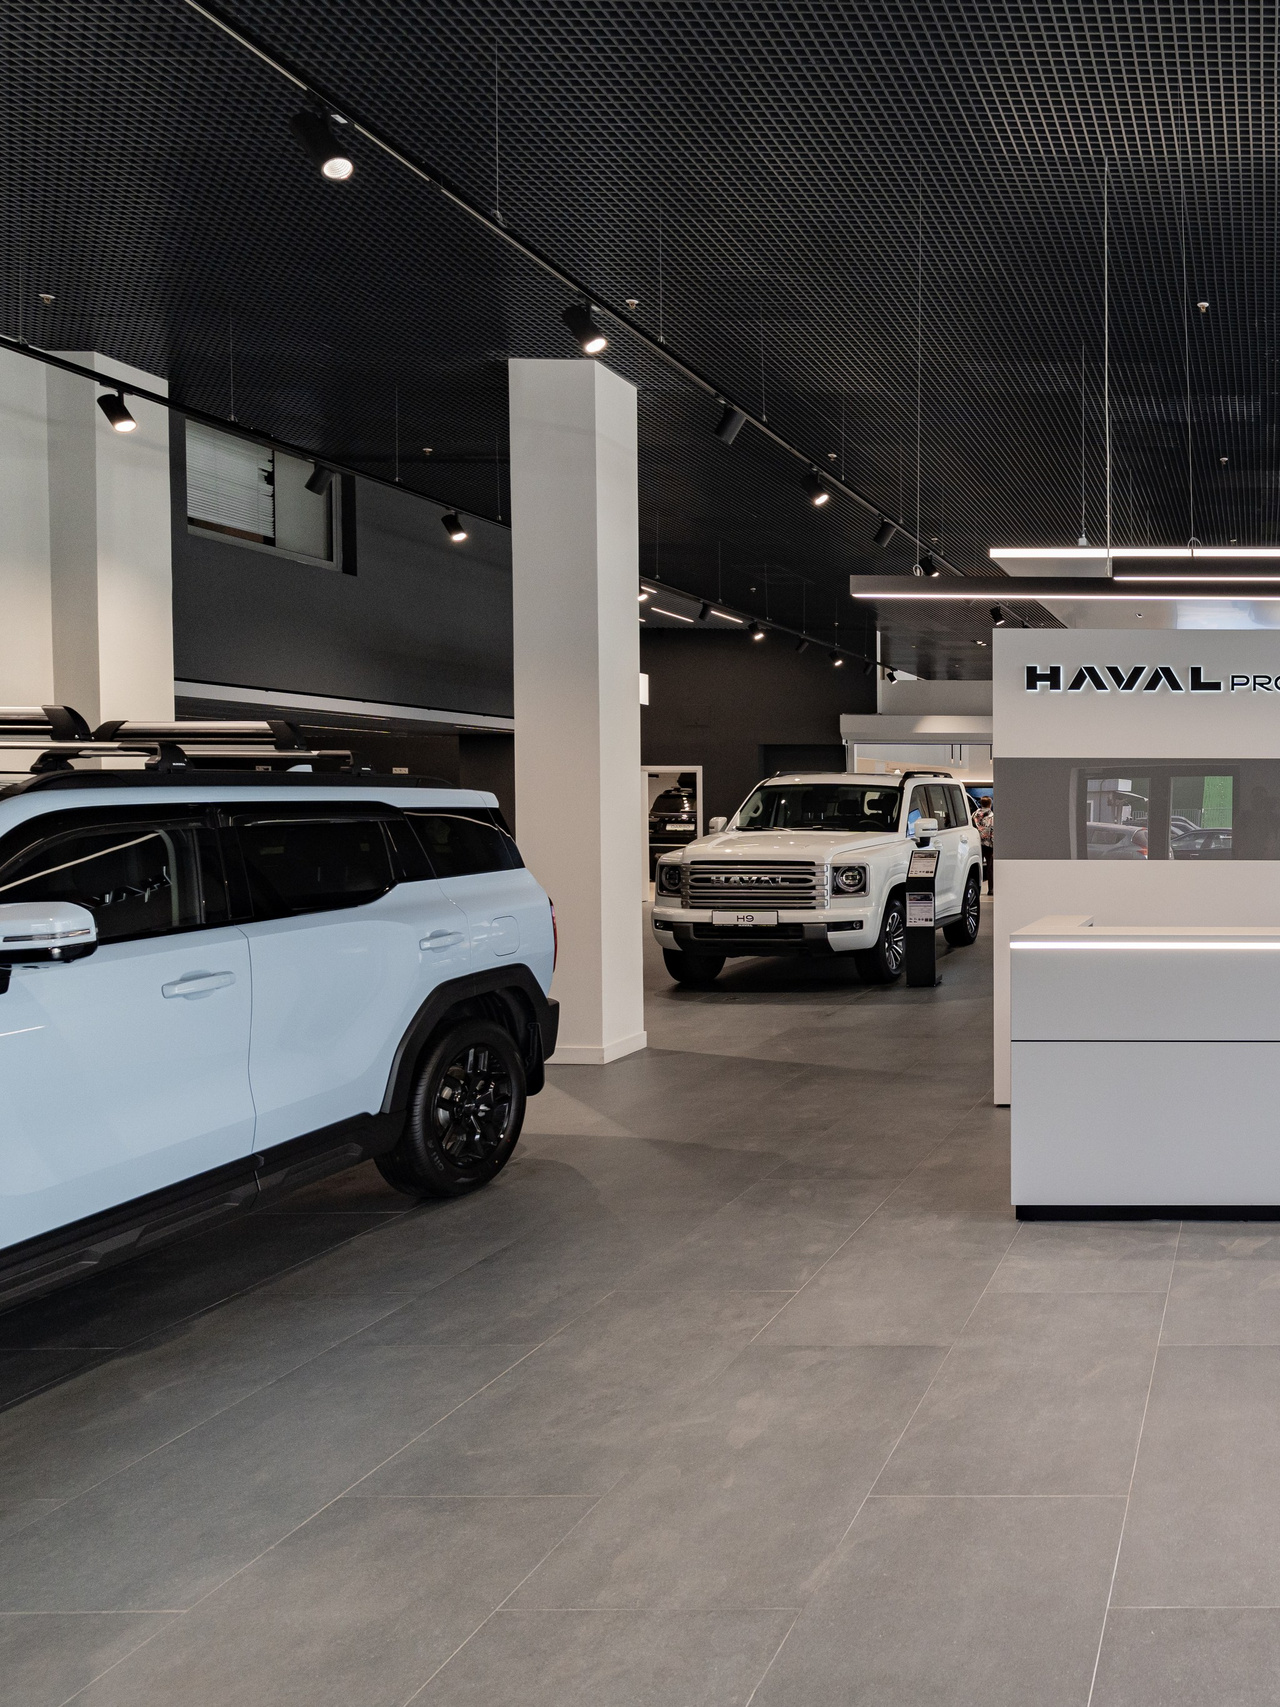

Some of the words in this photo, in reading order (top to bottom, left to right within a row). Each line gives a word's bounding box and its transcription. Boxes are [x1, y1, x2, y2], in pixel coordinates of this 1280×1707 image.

[1026, 665, 1222, 692] HAVAL
[710, 876, 790, 886] HAVAL
[736, 915, 755, 923] H9
